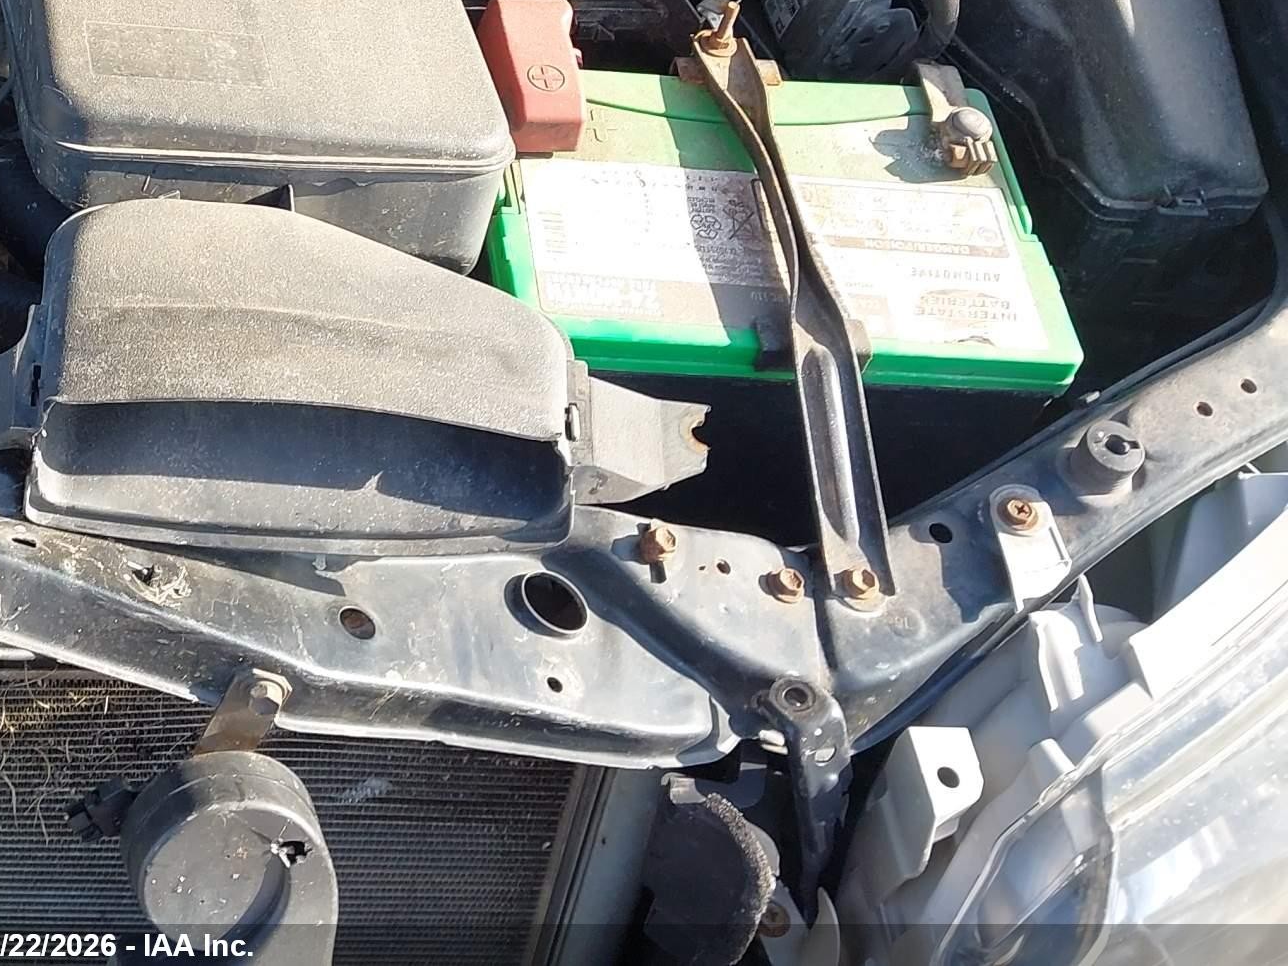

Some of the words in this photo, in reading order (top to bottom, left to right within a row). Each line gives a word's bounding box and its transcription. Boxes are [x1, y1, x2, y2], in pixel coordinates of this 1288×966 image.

[910, 266, 1001, 283] AUTOMOTIVE
[919, 295, 1011, 311] BATTERIES
[912, 305, 1018, 322] INTERSTATE
